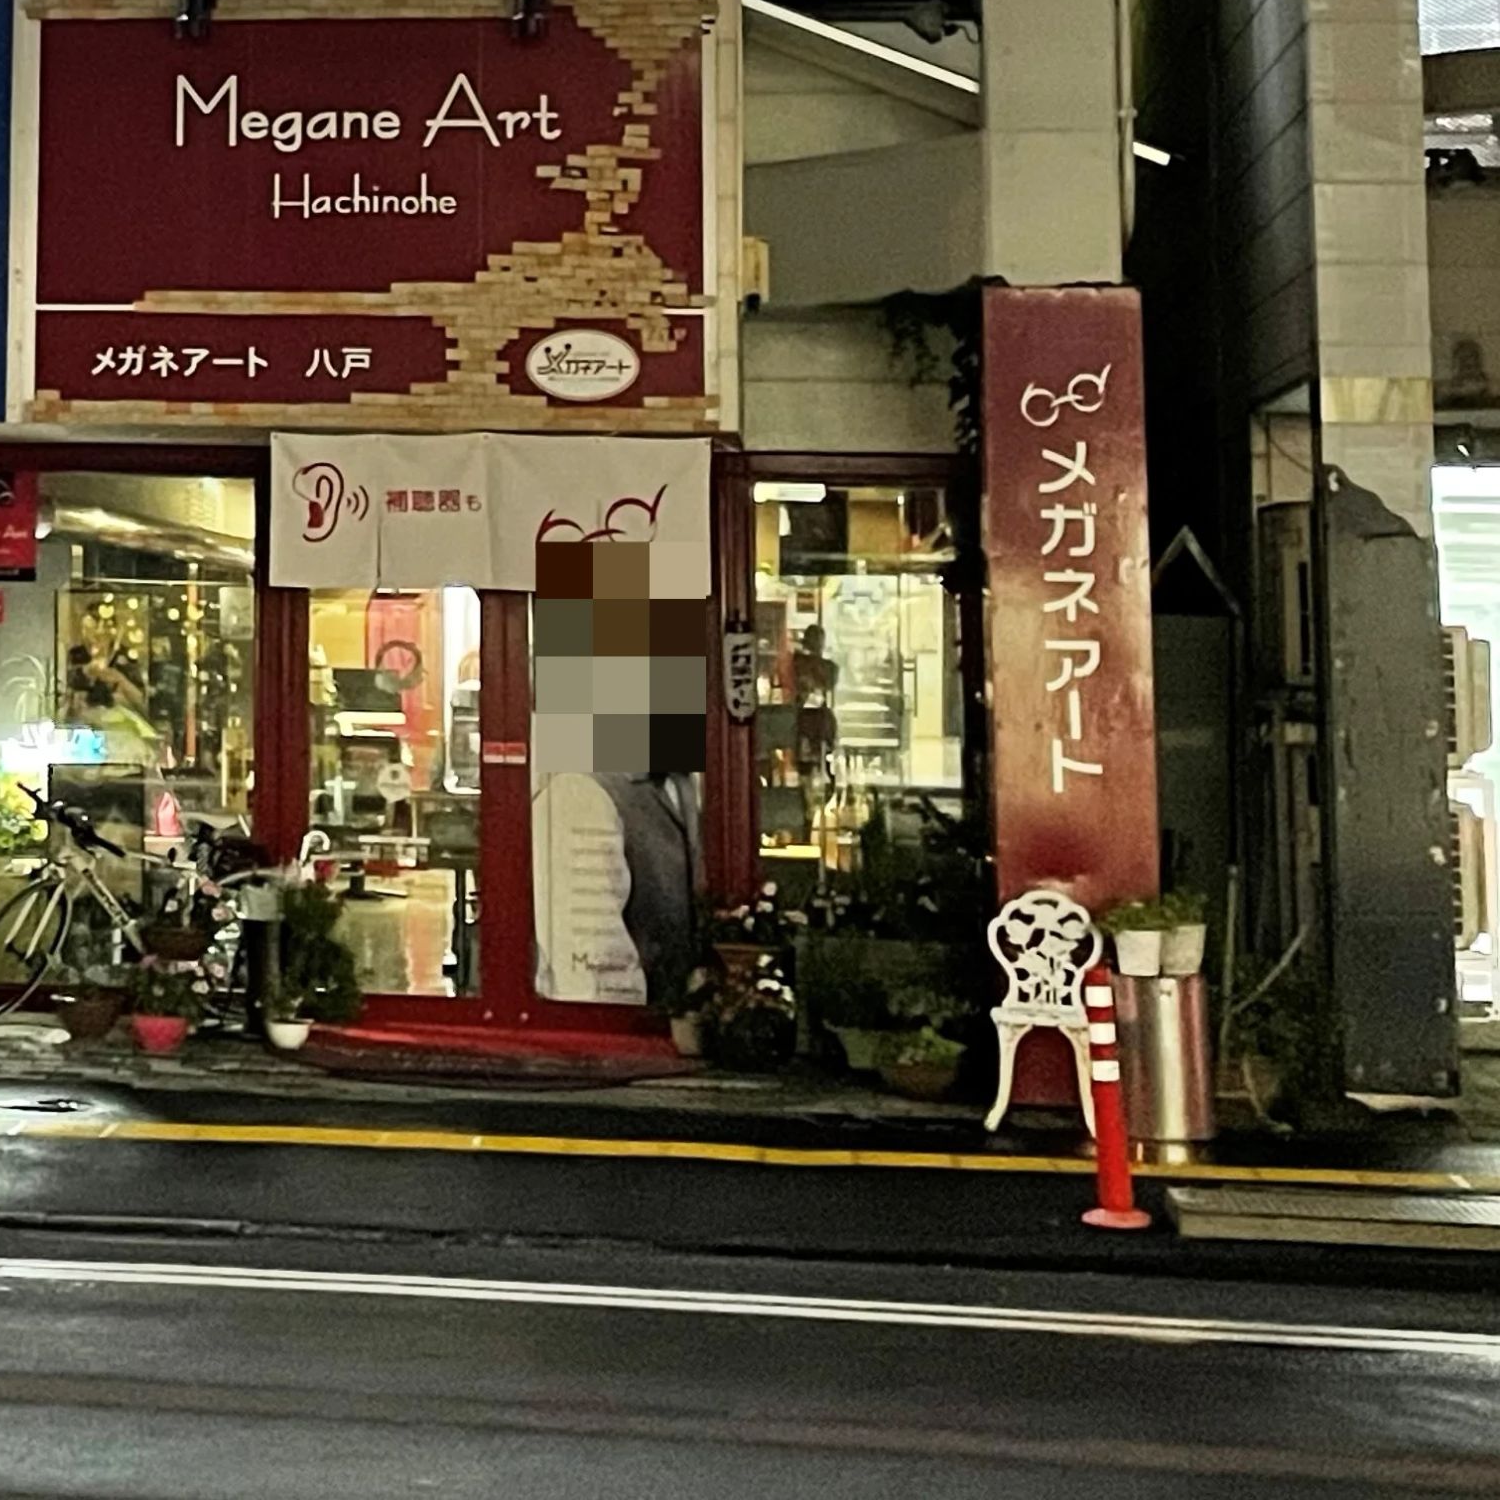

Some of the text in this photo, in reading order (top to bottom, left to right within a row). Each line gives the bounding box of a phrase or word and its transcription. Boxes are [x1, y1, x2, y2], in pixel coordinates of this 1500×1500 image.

[175, 73, 562, 152] Megane Art
[272, 173, 458, 219] Hachinohe
[91, 344, 373, 379] メガネアート 八戸
[1038, 440, 1104, 794] メガネアート
